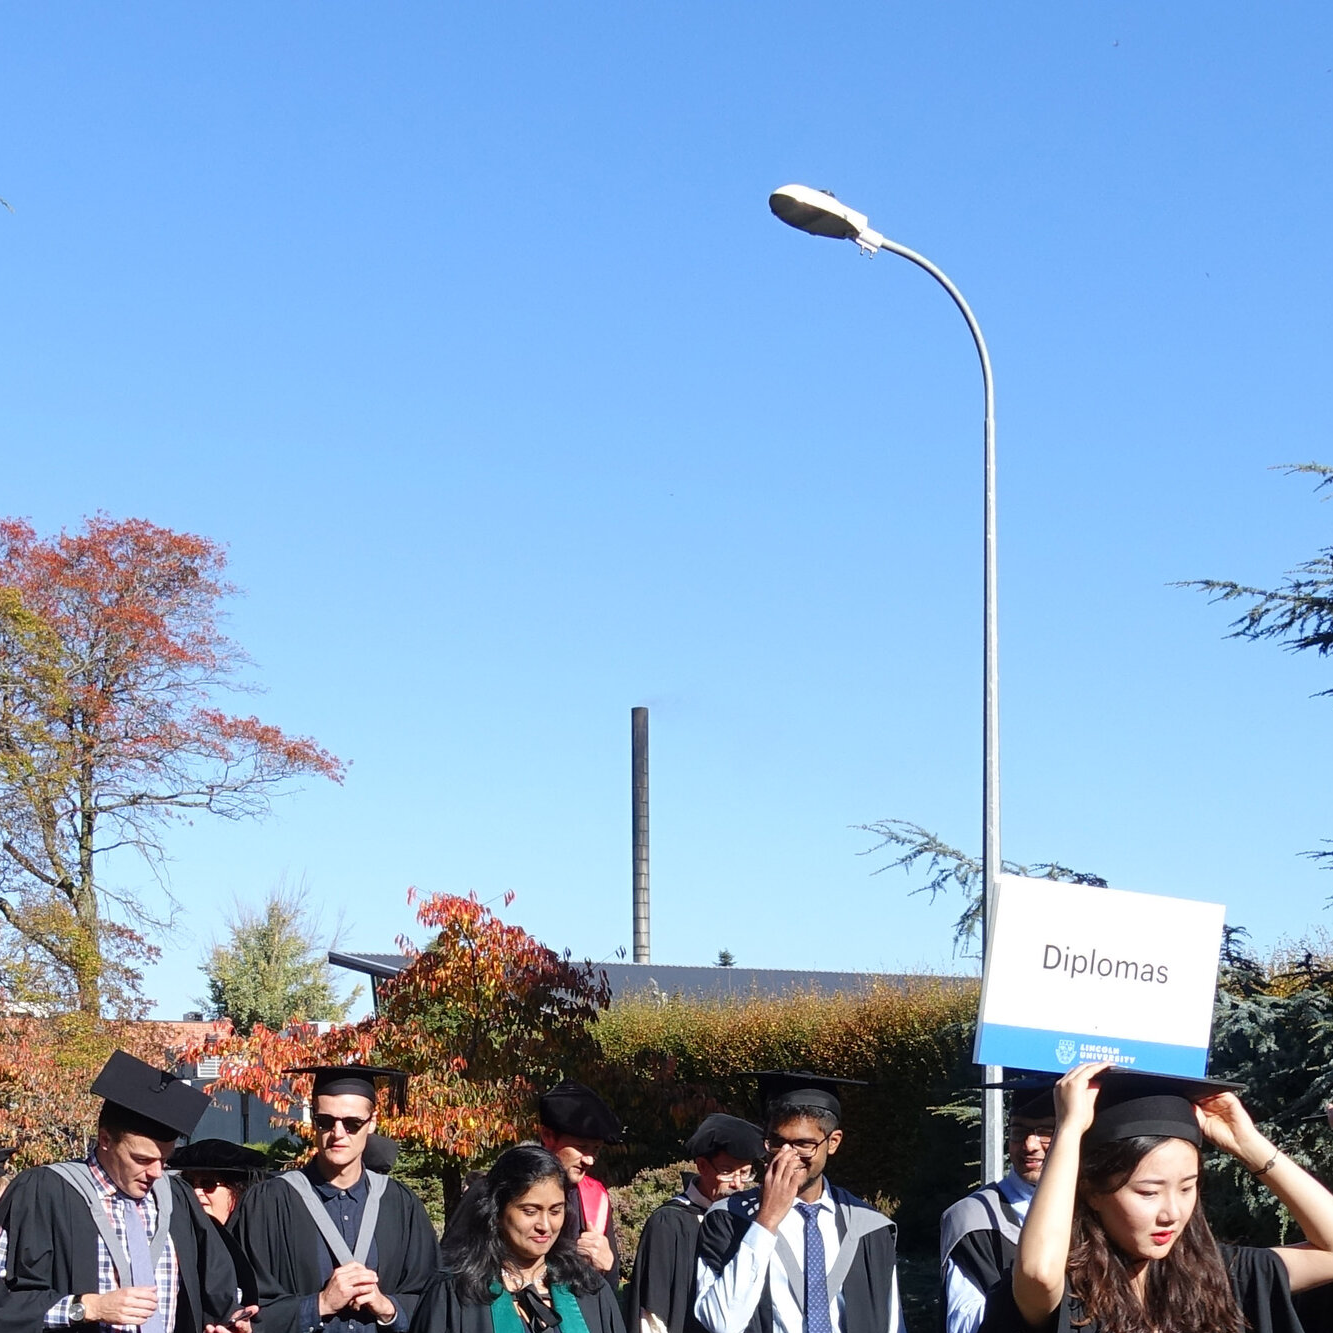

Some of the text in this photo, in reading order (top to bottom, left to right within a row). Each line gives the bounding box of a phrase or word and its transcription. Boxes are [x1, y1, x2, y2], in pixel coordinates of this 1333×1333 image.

[1043, 944, 1168, 984] Diplomas
[1079, 1044, 1120, 1055] LINCOLN
[1079, 1051, 1136, 1065] UNIVERSITY
